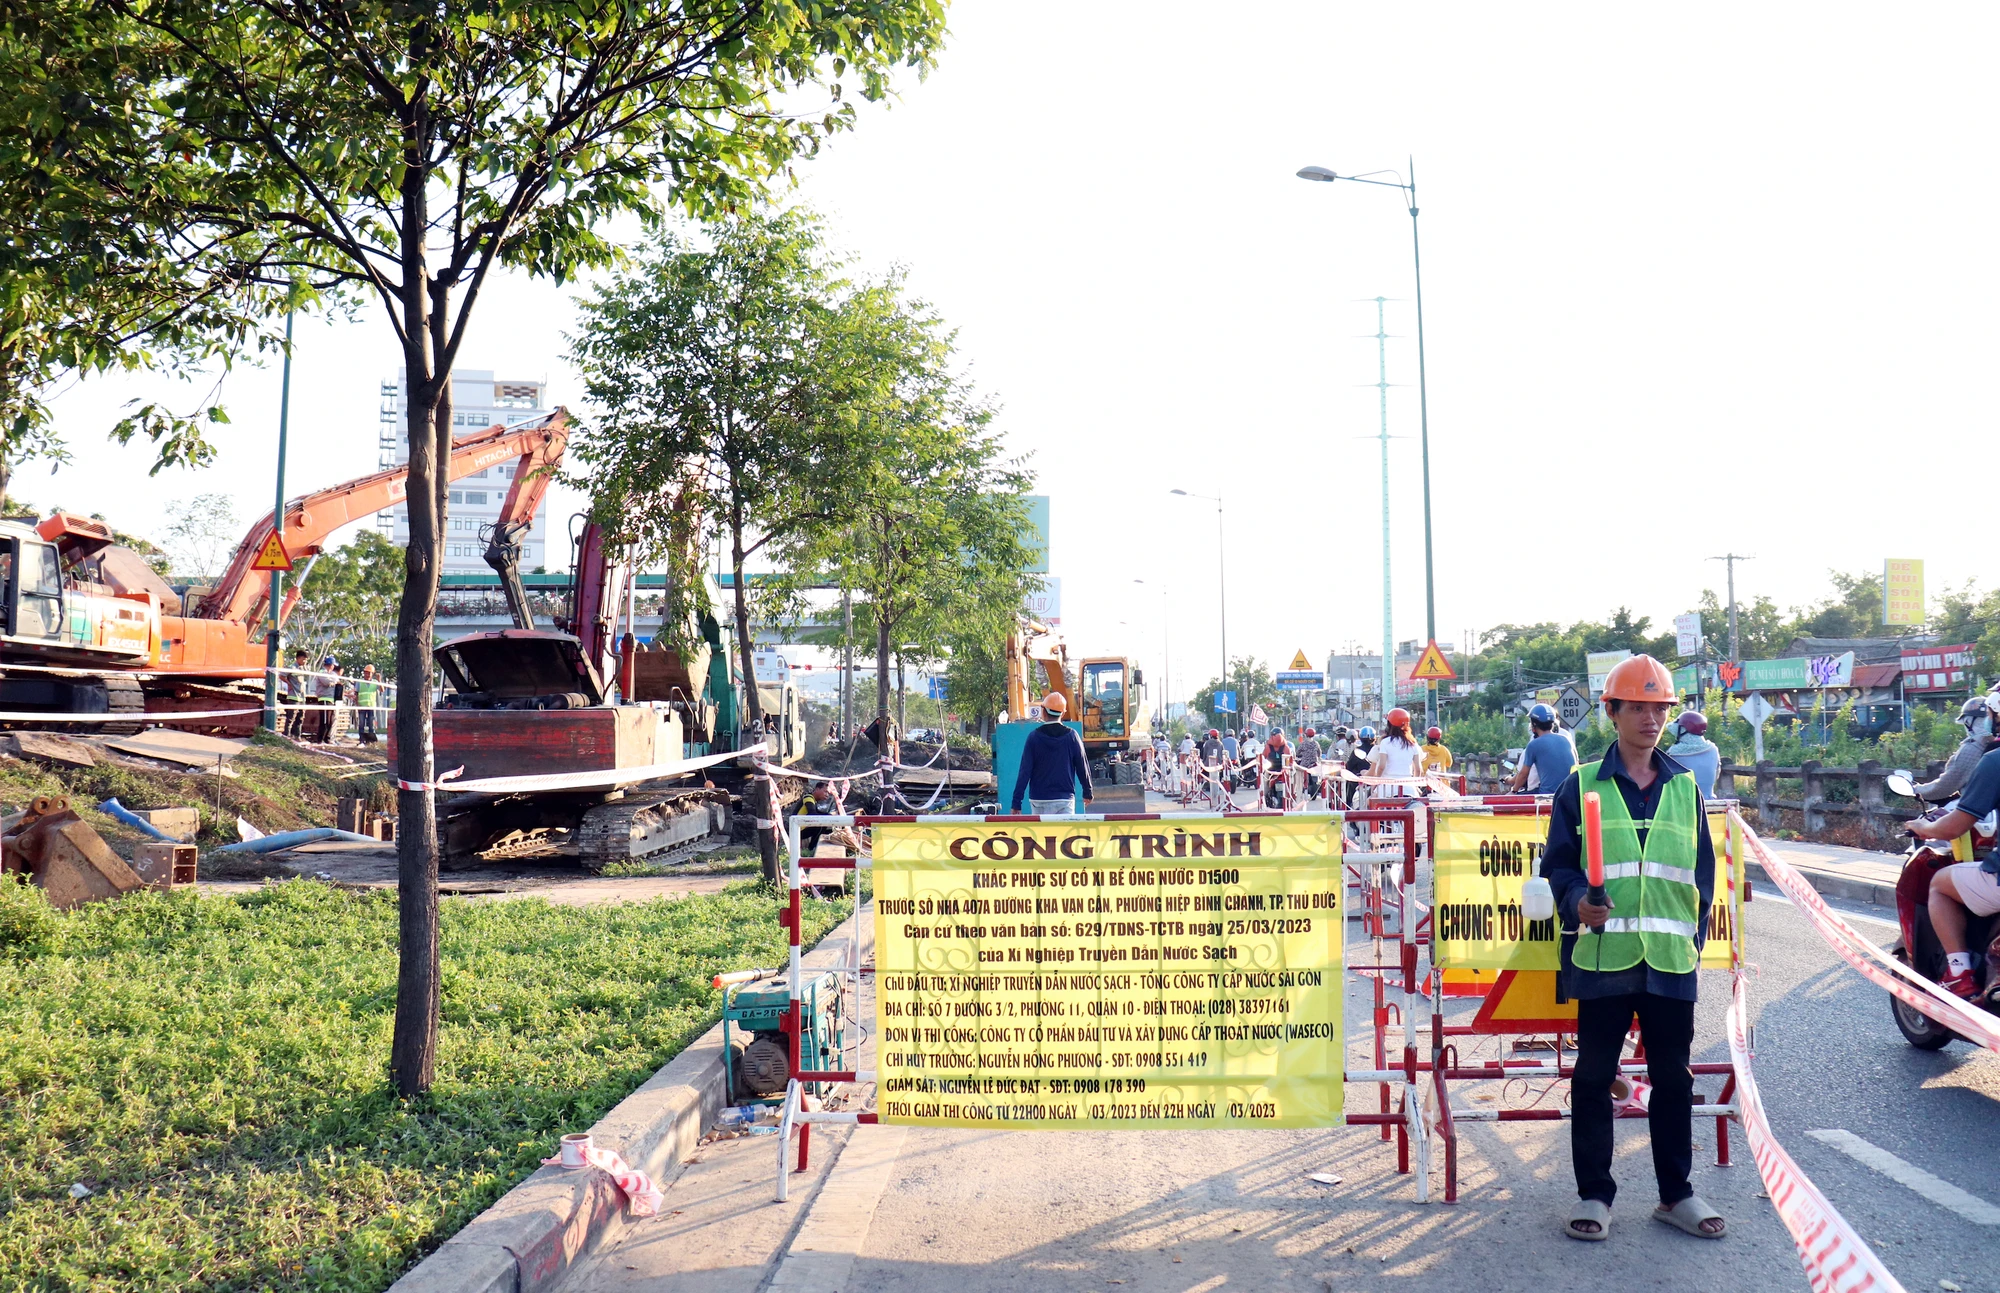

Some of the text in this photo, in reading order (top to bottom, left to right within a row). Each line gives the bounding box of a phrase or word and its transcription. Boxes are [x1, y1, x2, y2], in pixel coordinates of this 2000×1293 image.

[474, 447, 513, 467] HITACHI
[1891, 602, 1920, 610] HOA
[1719, 662, 1741, 687] Tiger
[1812, 656, 1840, 685] Tiger
[1563, 697, 1579, 707] KÉO
[949, 829, 1261, 861] CÔNG TRÌNH
[1480, 834, 1522, 877] CÔNG
[973, 868, 1007, 888] KHẮC
[1011, 873, 1045, 888] PHỤC
[1050, 870, 1067, 888] SỰ
[1071, 866, 1088, 887] CỐ
[1109, 867, 1125, 886] BỂ
[1129, 866, 1154, 886] ỐNG
[1159, 868, 1193, 885] NƯỚC
[1199, 869, 1240, 885] D1500
[879, 898, 915, 915] TRƯỚC
[918, 895, 934, 914] SỐ
[937, 897, 959, 914] NHÀ
[993, 896, 1032, 914] ĐƯỜNG
[1036, 898, 1058, 913] KHA
[1061, 898, 1084, 917] VẠN
[1116, 895, 1162, 912] PHƯỜNG
[1166, 895, 1190, 914] HIỆP
[1194, 895, 1221, 911] BÌNH
[1225, 892, 1266, 912] CHÁNH,
[1269, 895, 1284, 910] TP.
[1287, 891, 1309, 910] THỦ
[1312, 891, 1336, 909] ĐỨC
[904, 918, 1312, 939] Căn cứ theo văn bản số: 629/TDNS-TCTB ngày 25/03/2023
[1441, 898, 1493, 941] CHÚNG
[1498, 898, 1524, 941] TÔI
[1008, 948, 1021, 962] Xí
[1025, 947, 1074, 963] Nghiệp
[1078, 945, 1127, 965] Truyền
[1131, 941, 1159, 961] Dẫn
[1163, 945, 1197, 960] Nước
[1202, 945, 1237, 963] Sạch
[907, 970, 928, 991] ĐẦU
[931, 975, 947, 991] TƯ:
[950, 973, 960, 991] XÍ
[963, 975, 1001, 992] NGHIỆP
[1003, 969, 1042, 991] TRUYỀN
[1045, 969, 1067, 990] DẪN
[1070, 972, 1101, 990] NƯỚC
[1103, 974, 1131, 992] SẠCH
[1140, 969, 1170, 990] TỔNG
[1173, 970, 1204, 989] CÔNG
[1207, 972, 1220, 989] TY
[1222, 968, 1243, 988] CẤP
[1245, 970, 1276, 988] NƯỚC
[1278, 969, 1294, 988] SÀI
[1297, 969, 1321, 987] GÒN
[885, 1002, 903, 1018] ĐỊA
[928, 998, 943, 1017] SỐ
[945, 1002, 952, 1017] 7
[954, 999, 992, 1017] ĐƯỜNG
[995, 1001, 1018, 1018] 3/2,
[1020, 999, 1065, 1016] PHƯỜNG
[1069, 1002, 1085, 1018] 11,
[1087, 998, 1117, 1017] QUẬN
[1122, 1001, 1134, 1016] 10
[1143, 999, 1167, 1017] ĐIỆN
[1170, 1000, 1205, 1017] THOẠI:
[1207, 999, 1236, 1018] (028)
[1239, 999, 1290, 1014] 38397161
[885, 1021, 1334, 1047] ĐƠN VỊ THI CÔNG: CÔNG TY CỔ PHẦN ĐẦU TƯ VÀ XÂY DỰNG CẤP THOÁT NƯỚC (WASECO)
[906, 1054, 926, 1068] HUY
[978, 1048, 1020, 1068] NGUYỄN
[1023, 1050, 1055, 1068] HỒNG
[1057, 1052, 1102, 1068] PHƯƠNG
[1112, 1052, 1133, 1068] SĐT:
[1136, 1052, 1163, 1067] 0908
[1165, 1052, 1184, 1067] 551
[1188, 1052, 1207, 1067] 419
[886, 1073, 1145, 1095] GIÁM SÁT: NGUYỄN LÊ ĐỨC ĐẠT SĐT: 0908 178 390
[886, 1099, 1276, 1121] THỜI GIAN THI CÔNG TỪ 22H00 NGÀY /03/2023 ĐẾN 22H NGÀY /03/2023
